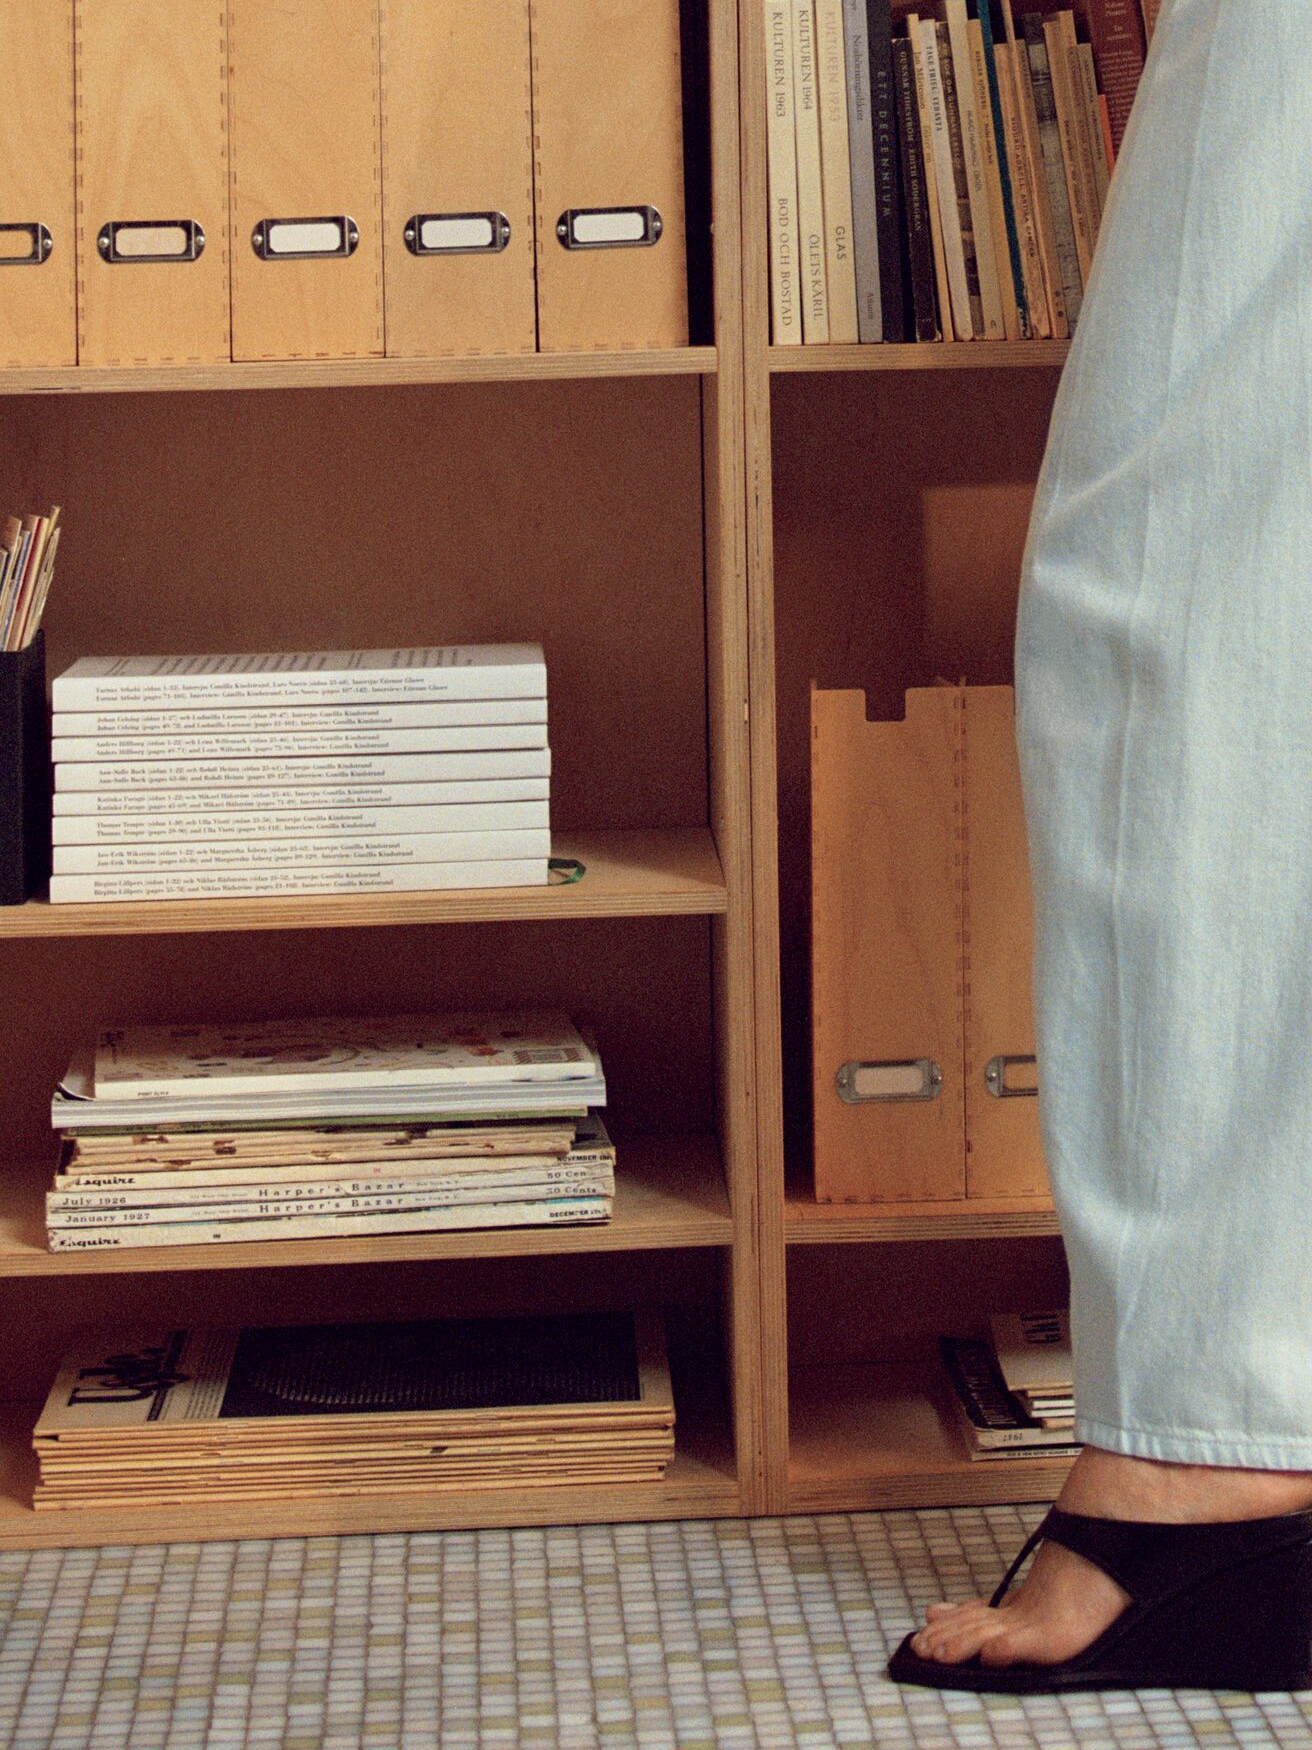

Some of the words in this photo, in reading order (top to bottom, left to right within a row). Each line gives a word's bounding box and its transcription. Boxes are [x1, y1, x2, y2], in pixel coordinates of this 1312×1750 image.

[773, 11, 785, 86] KULTUREN
[799, 9, 812, 81] KULTUREN
[776, 92, 786, 117] 1963
[801, 86, 813, 109] 1964
[880, 111, 891, 216] DECENNIUM
[778, 198, 789, 226] BOD
[780, 232, 790, 264] OCH
[835, 226, 846, 259] GLAS
[781, 271, 793, 326] BOSTAD
[63, 1197, 93, 1206] July
[99, 1196, 127, 1204] 1926
[352, 1182, 404, 1192] Bazar
[66, 1212, 116, 1224] January
[123, 1212, 150, 1220] 1927
[352, 1198, 404, 1208] Bazar
